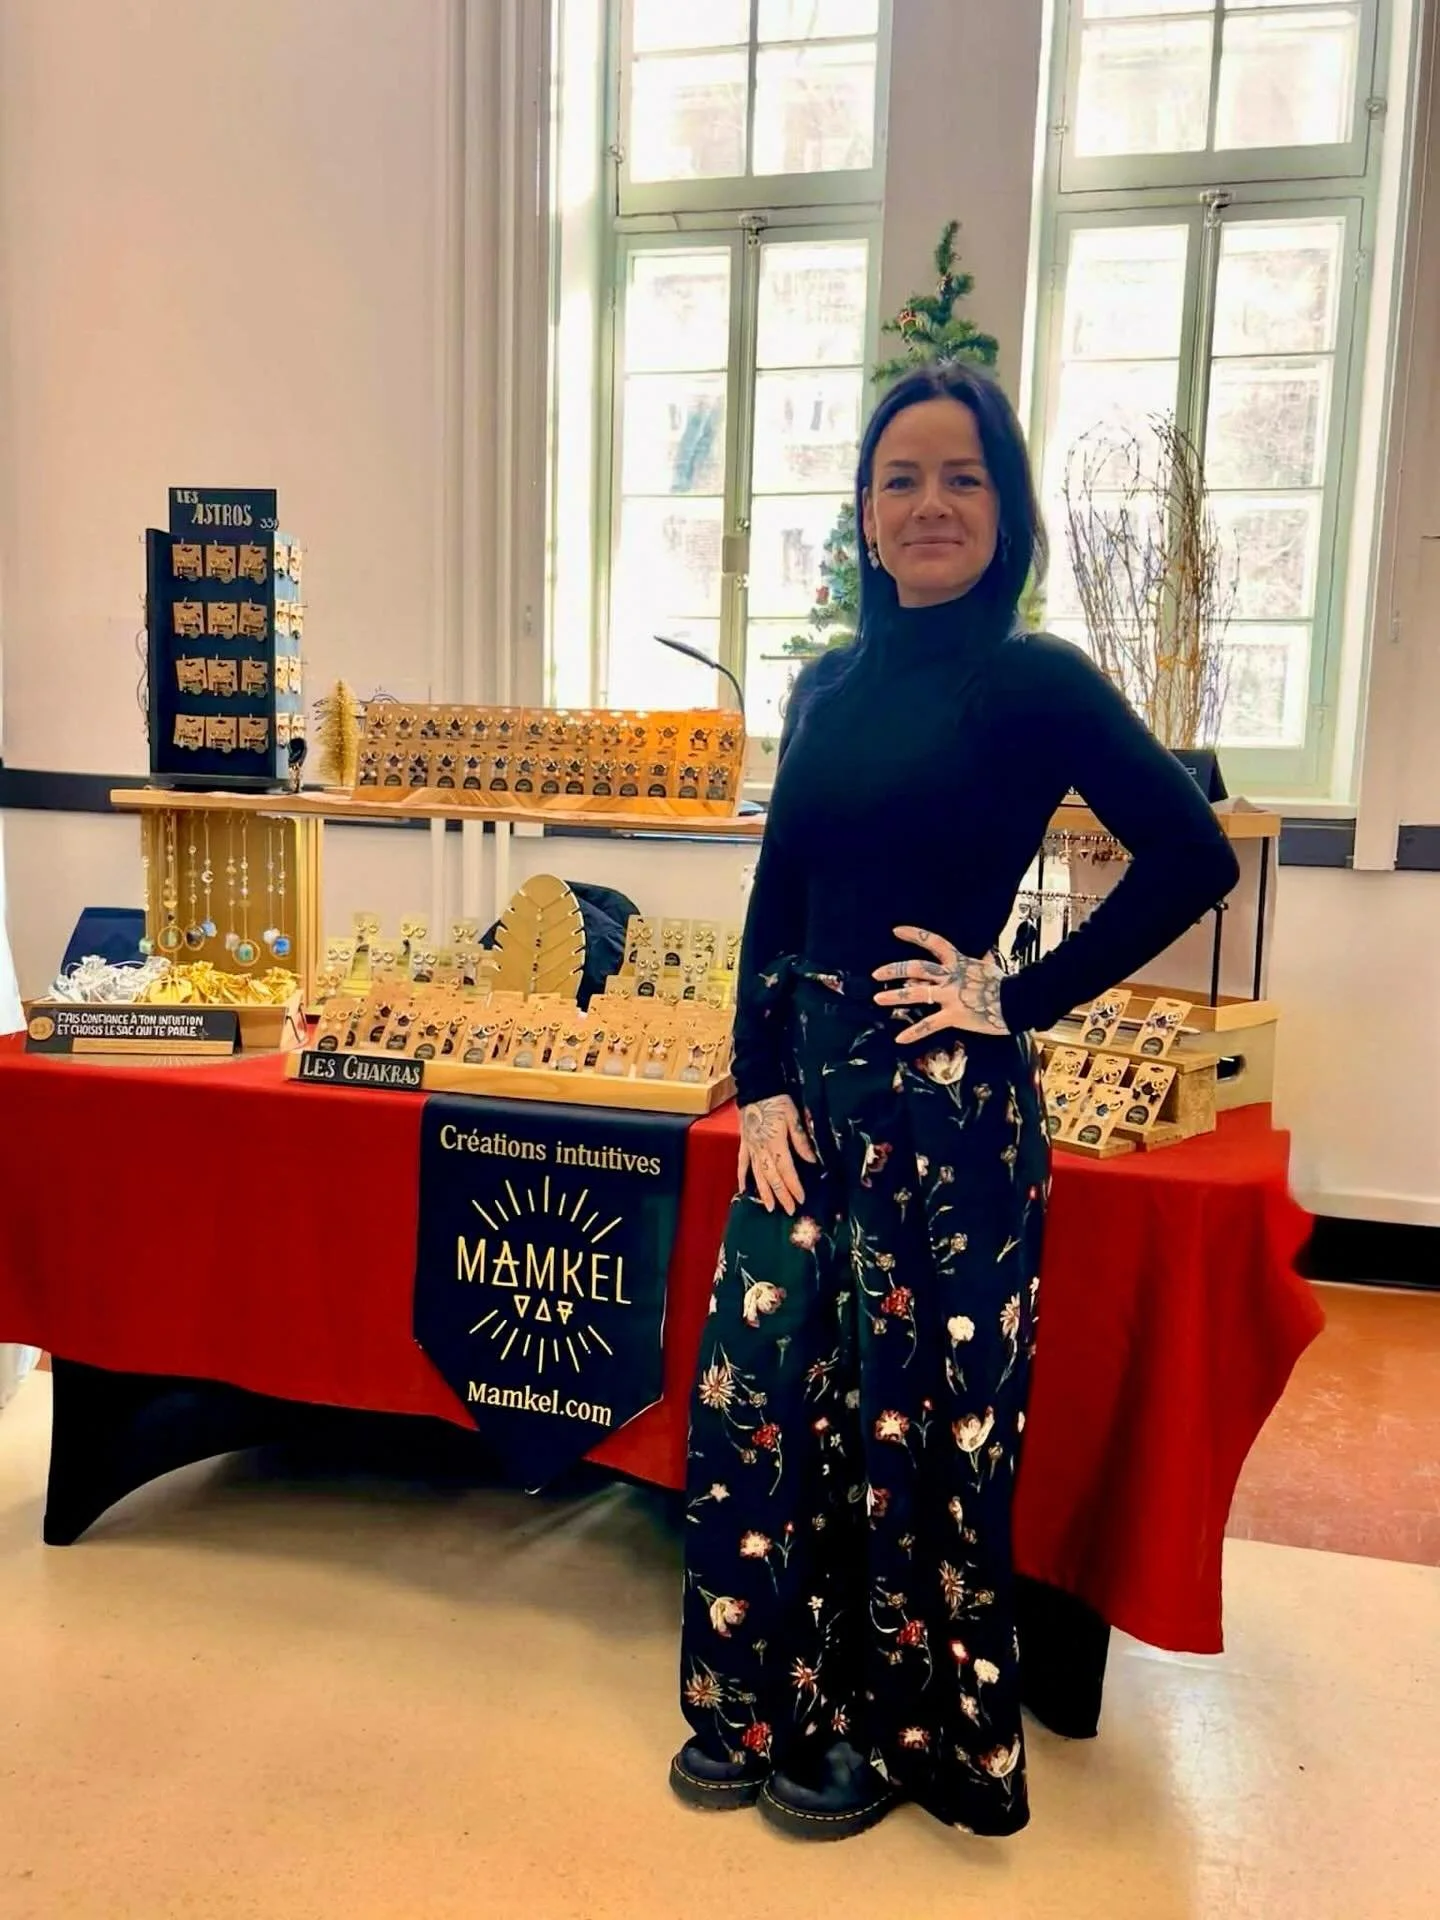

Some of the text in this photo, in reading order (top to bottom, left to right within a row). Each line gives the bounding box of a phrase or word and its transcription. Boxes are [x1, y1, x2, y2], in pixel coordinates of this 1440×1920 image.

[176, 490, 199, 504] LES
[191, 503, 253, 526] ASTROS
[57, 1024, 198, 1037] ET CHOISIS LE SAC QUI TE PARLE
[81, 1013, 129, 1025] CONFIANCE
[129, 1011, 138, 1025] À
[138, 1013, 157, 1025] TON
[158, 1014, 204, 1026] INTUITION
[303, 1054, 421, 1086] LES CHAKRAS
[440, 1124, 662, 1175] Créations intuitives
[457, 1235, 632, 1305] MAMKEL
[467, 1381, 612, 1427] Mamkel.com
